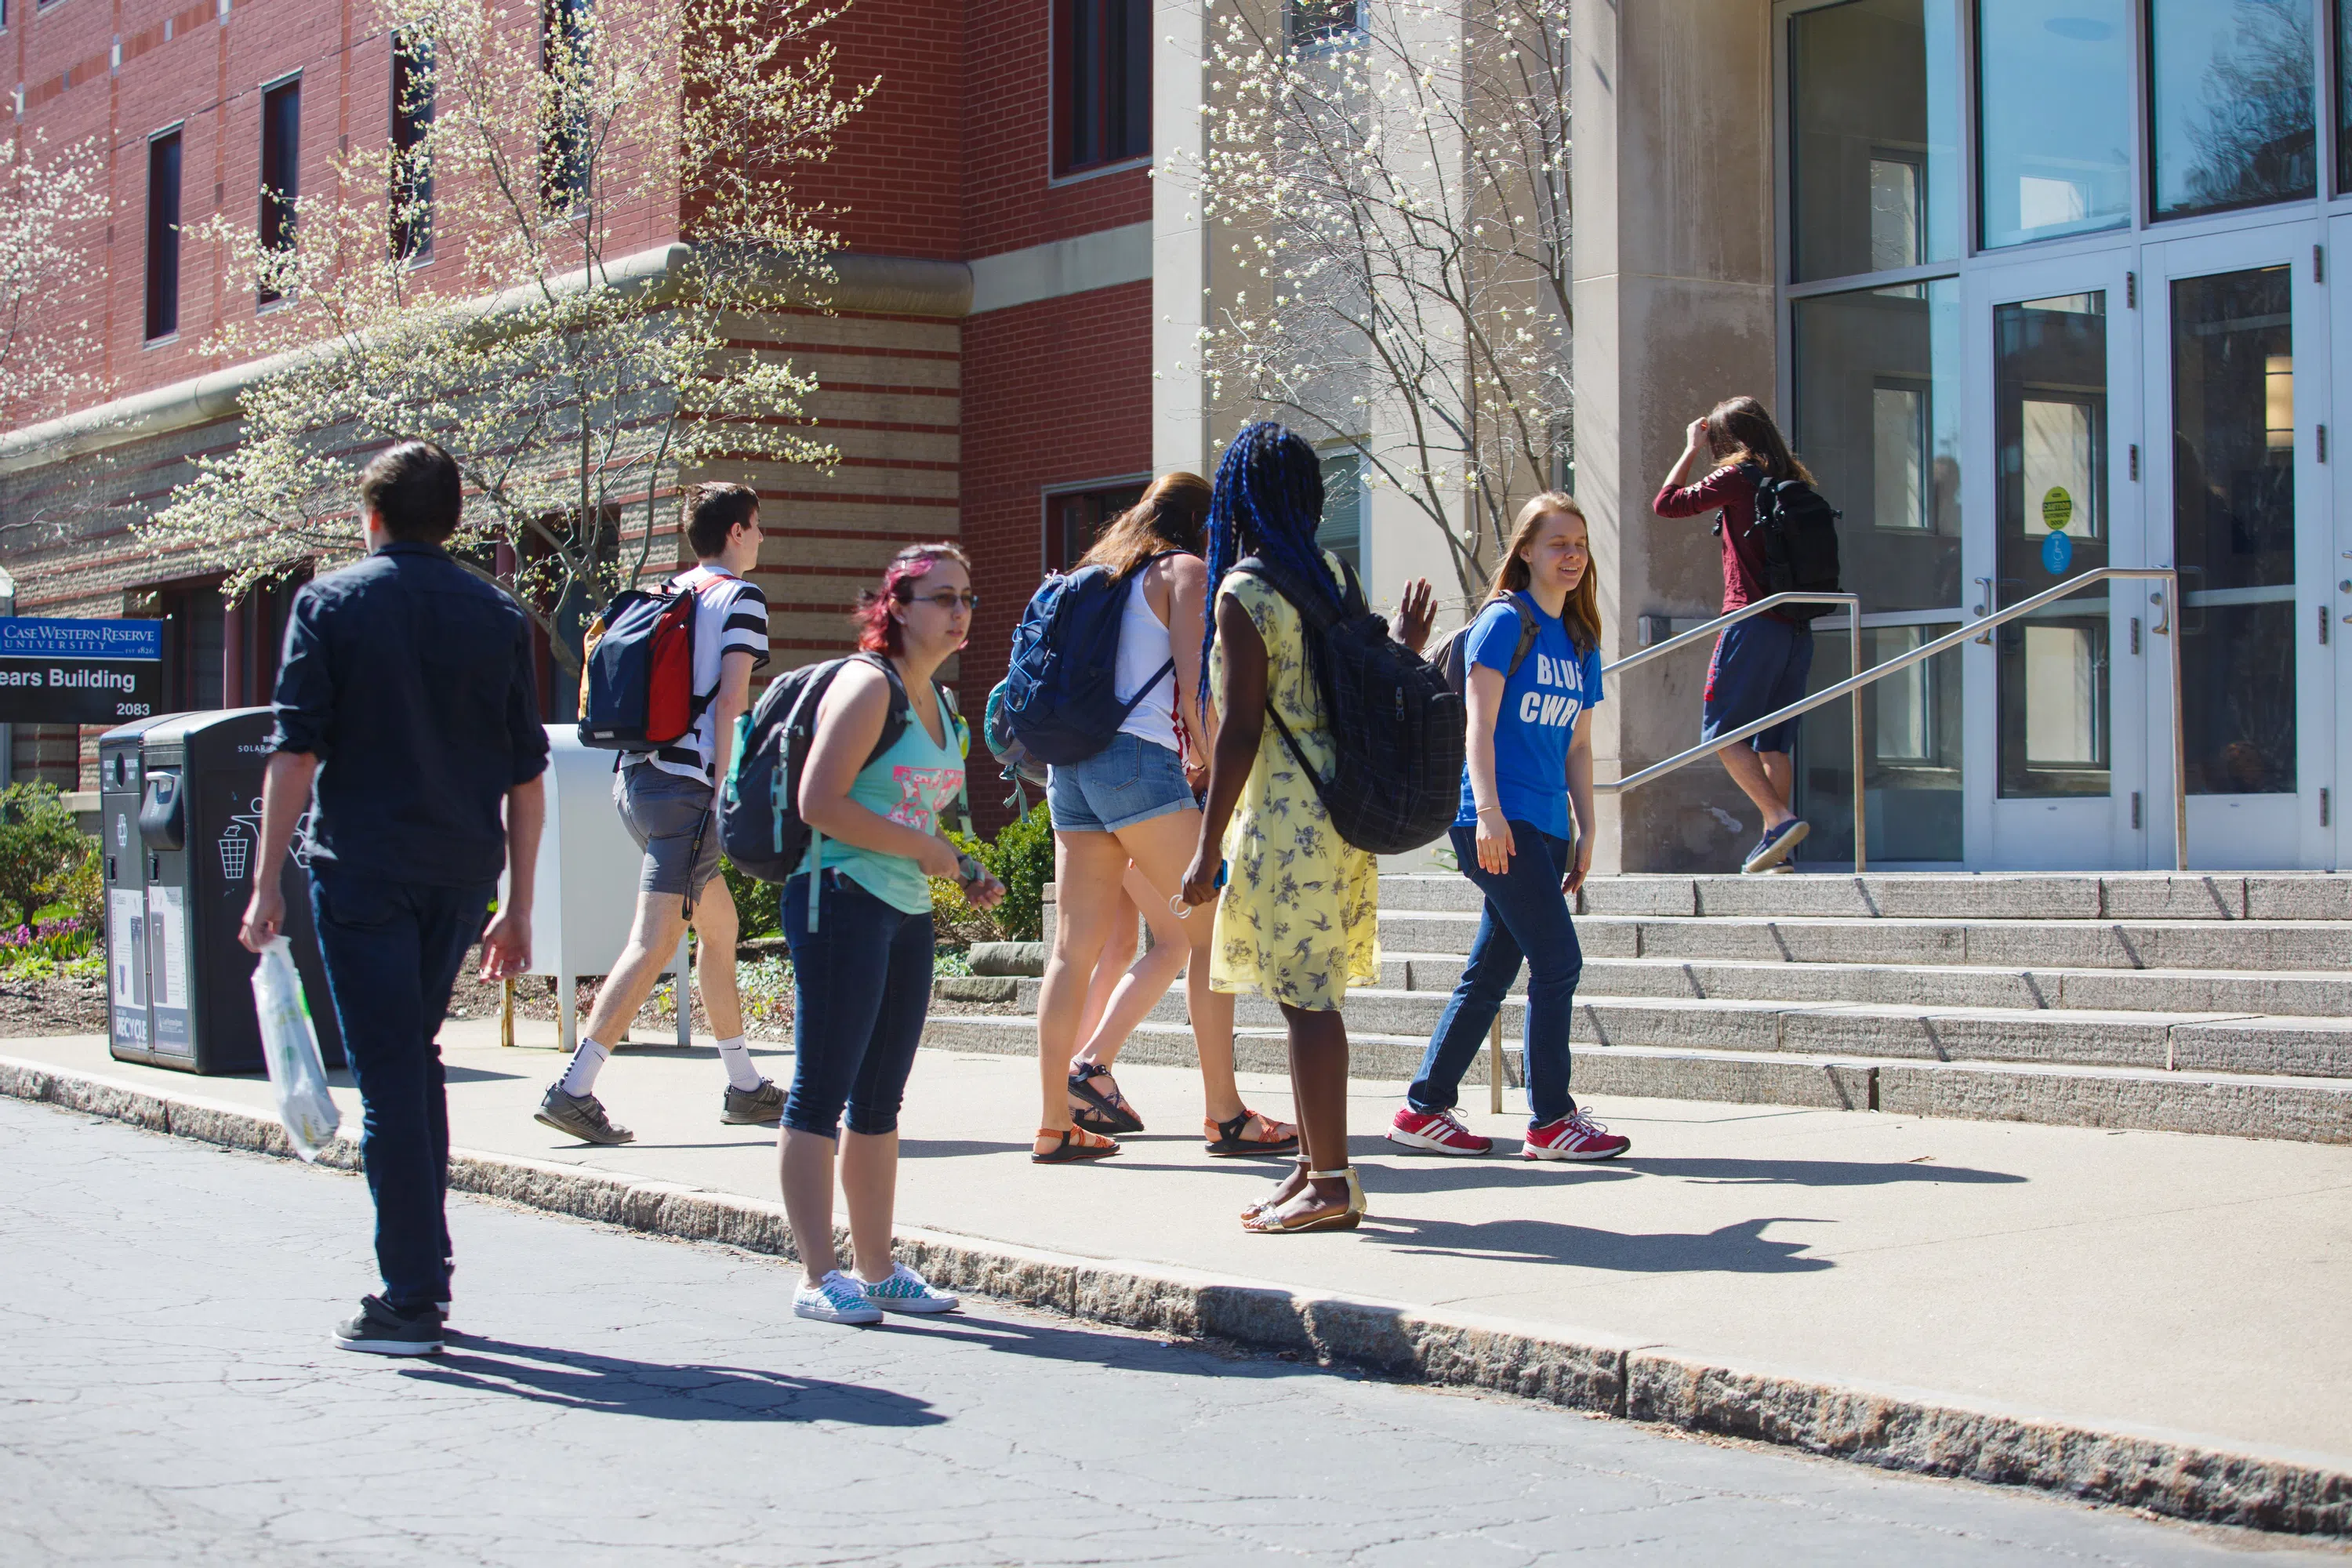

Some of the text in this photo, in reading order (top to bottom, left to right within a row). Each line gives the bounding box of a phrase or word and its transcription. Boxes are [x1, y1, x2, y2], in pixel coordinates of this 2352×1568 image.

[4, 625, 154, 643] CASE WESTERN RESERVE
[4, 640, 106, 651] UNIVERSITY
[137, 646, 154, 655] 1826
[1537, 653, 1583, 691] BLUE
[49, 668, 136, 693] Building
[116, 702, 151, 716] 2083
[238, 744, 266, 753] SOLAR
[116, 1015, 147, 1041] RECYCLE
